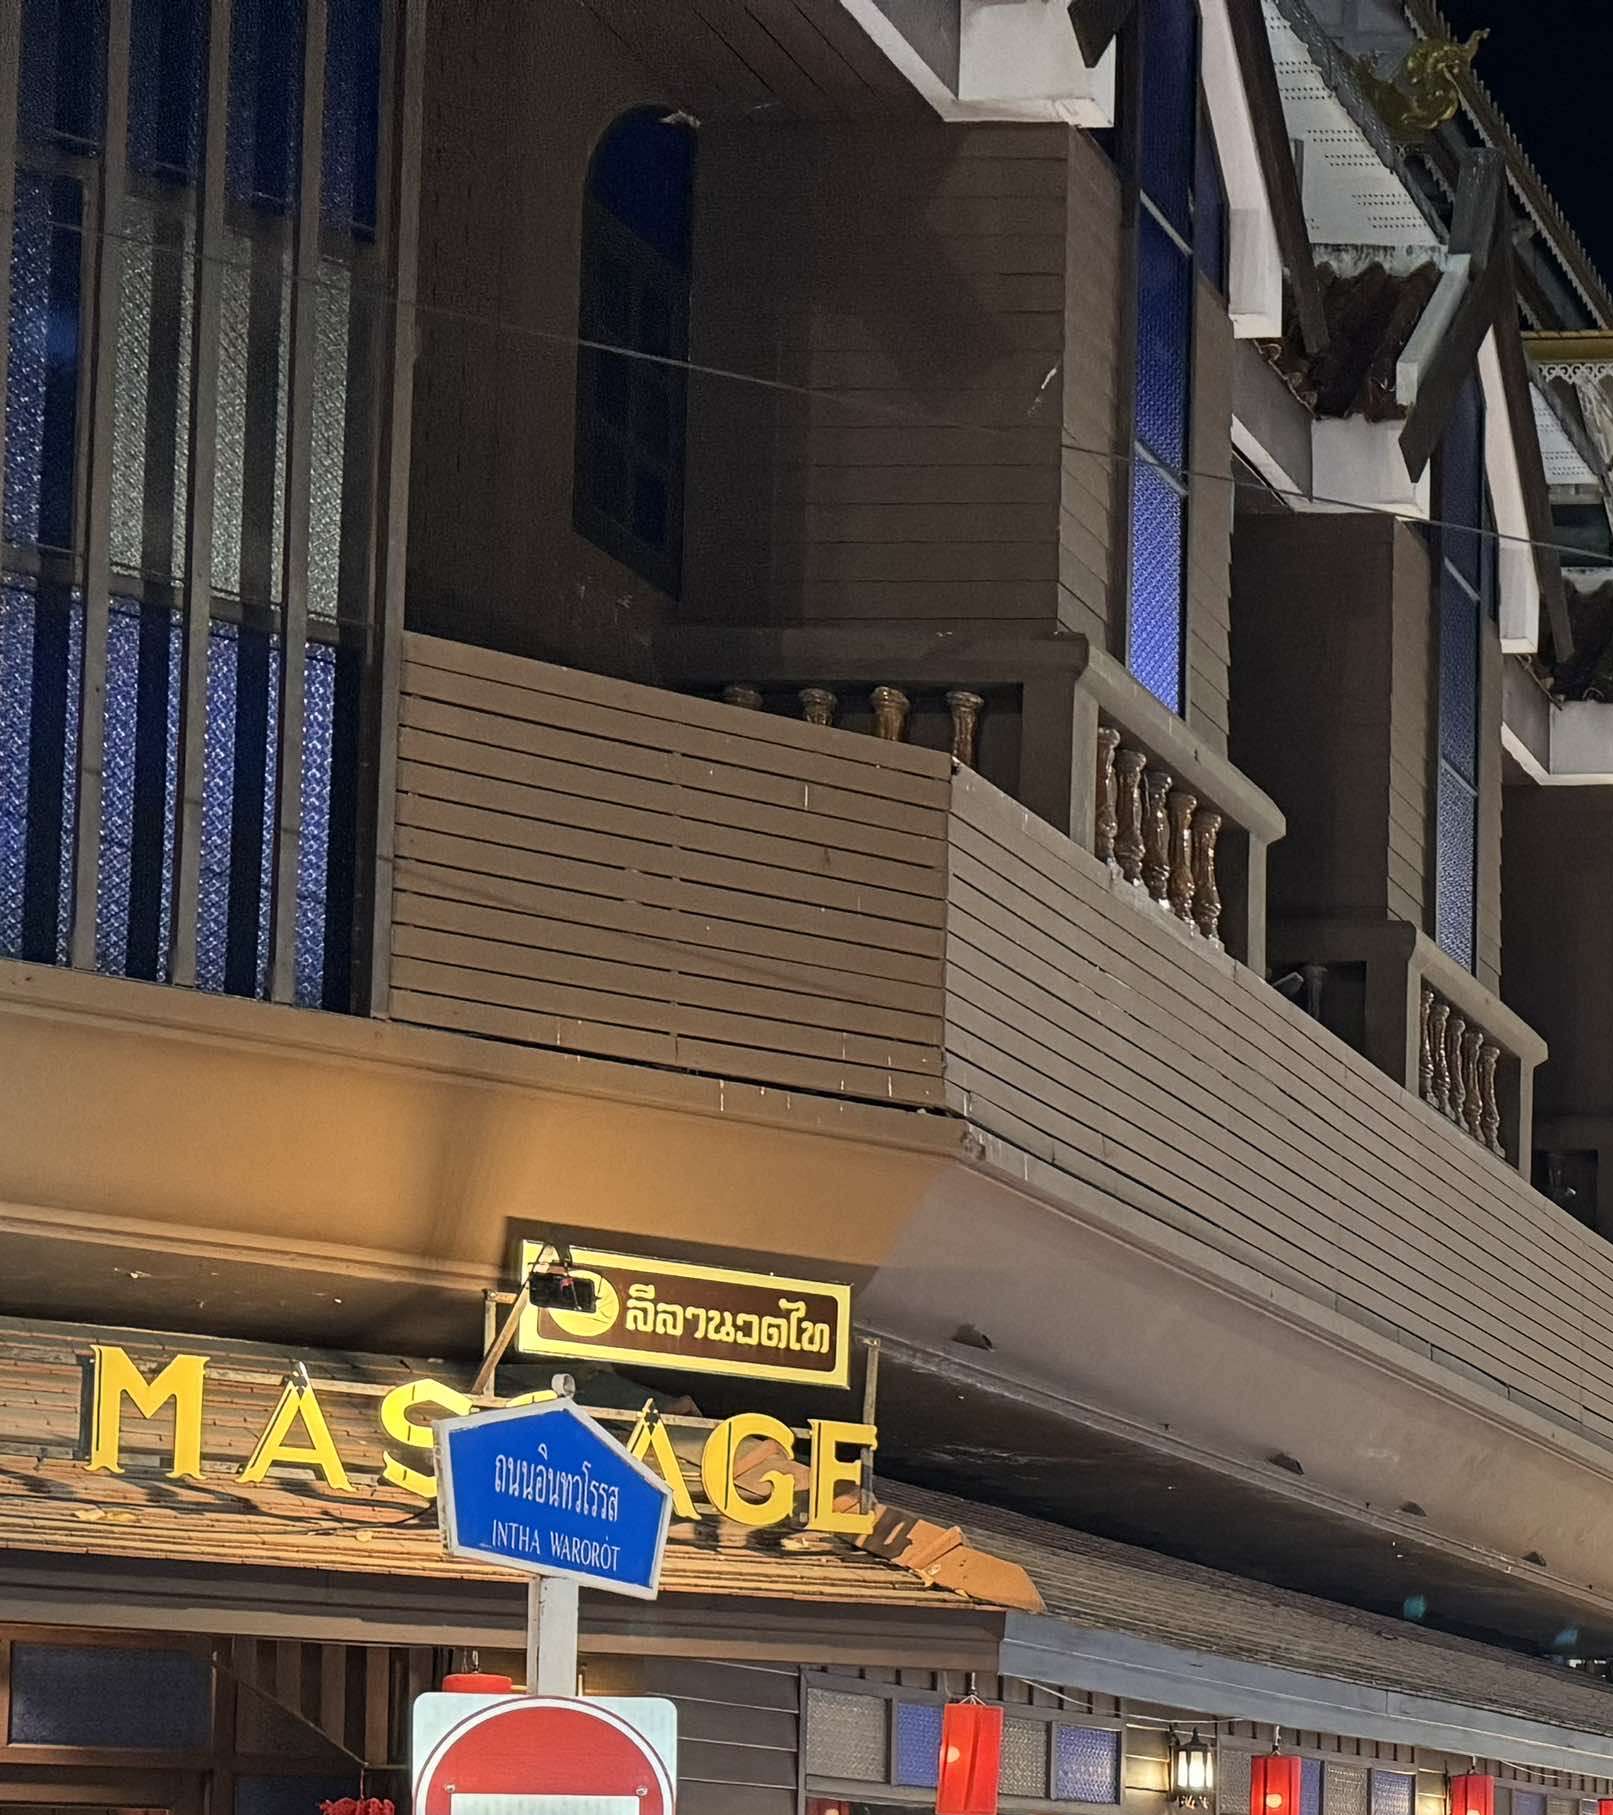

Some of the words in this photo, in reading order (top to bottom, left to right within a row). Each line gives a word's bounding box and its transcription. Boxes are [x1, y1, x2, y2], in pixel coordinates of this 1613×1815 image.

[83, 1344, 878, 1535] MASAGE
[494, 1443, 620, 1522] ถนนอินทวโรรส
[491, 1518, 541, 1556] INTHA
[550, 1530, 621, 1572] WAROROT
